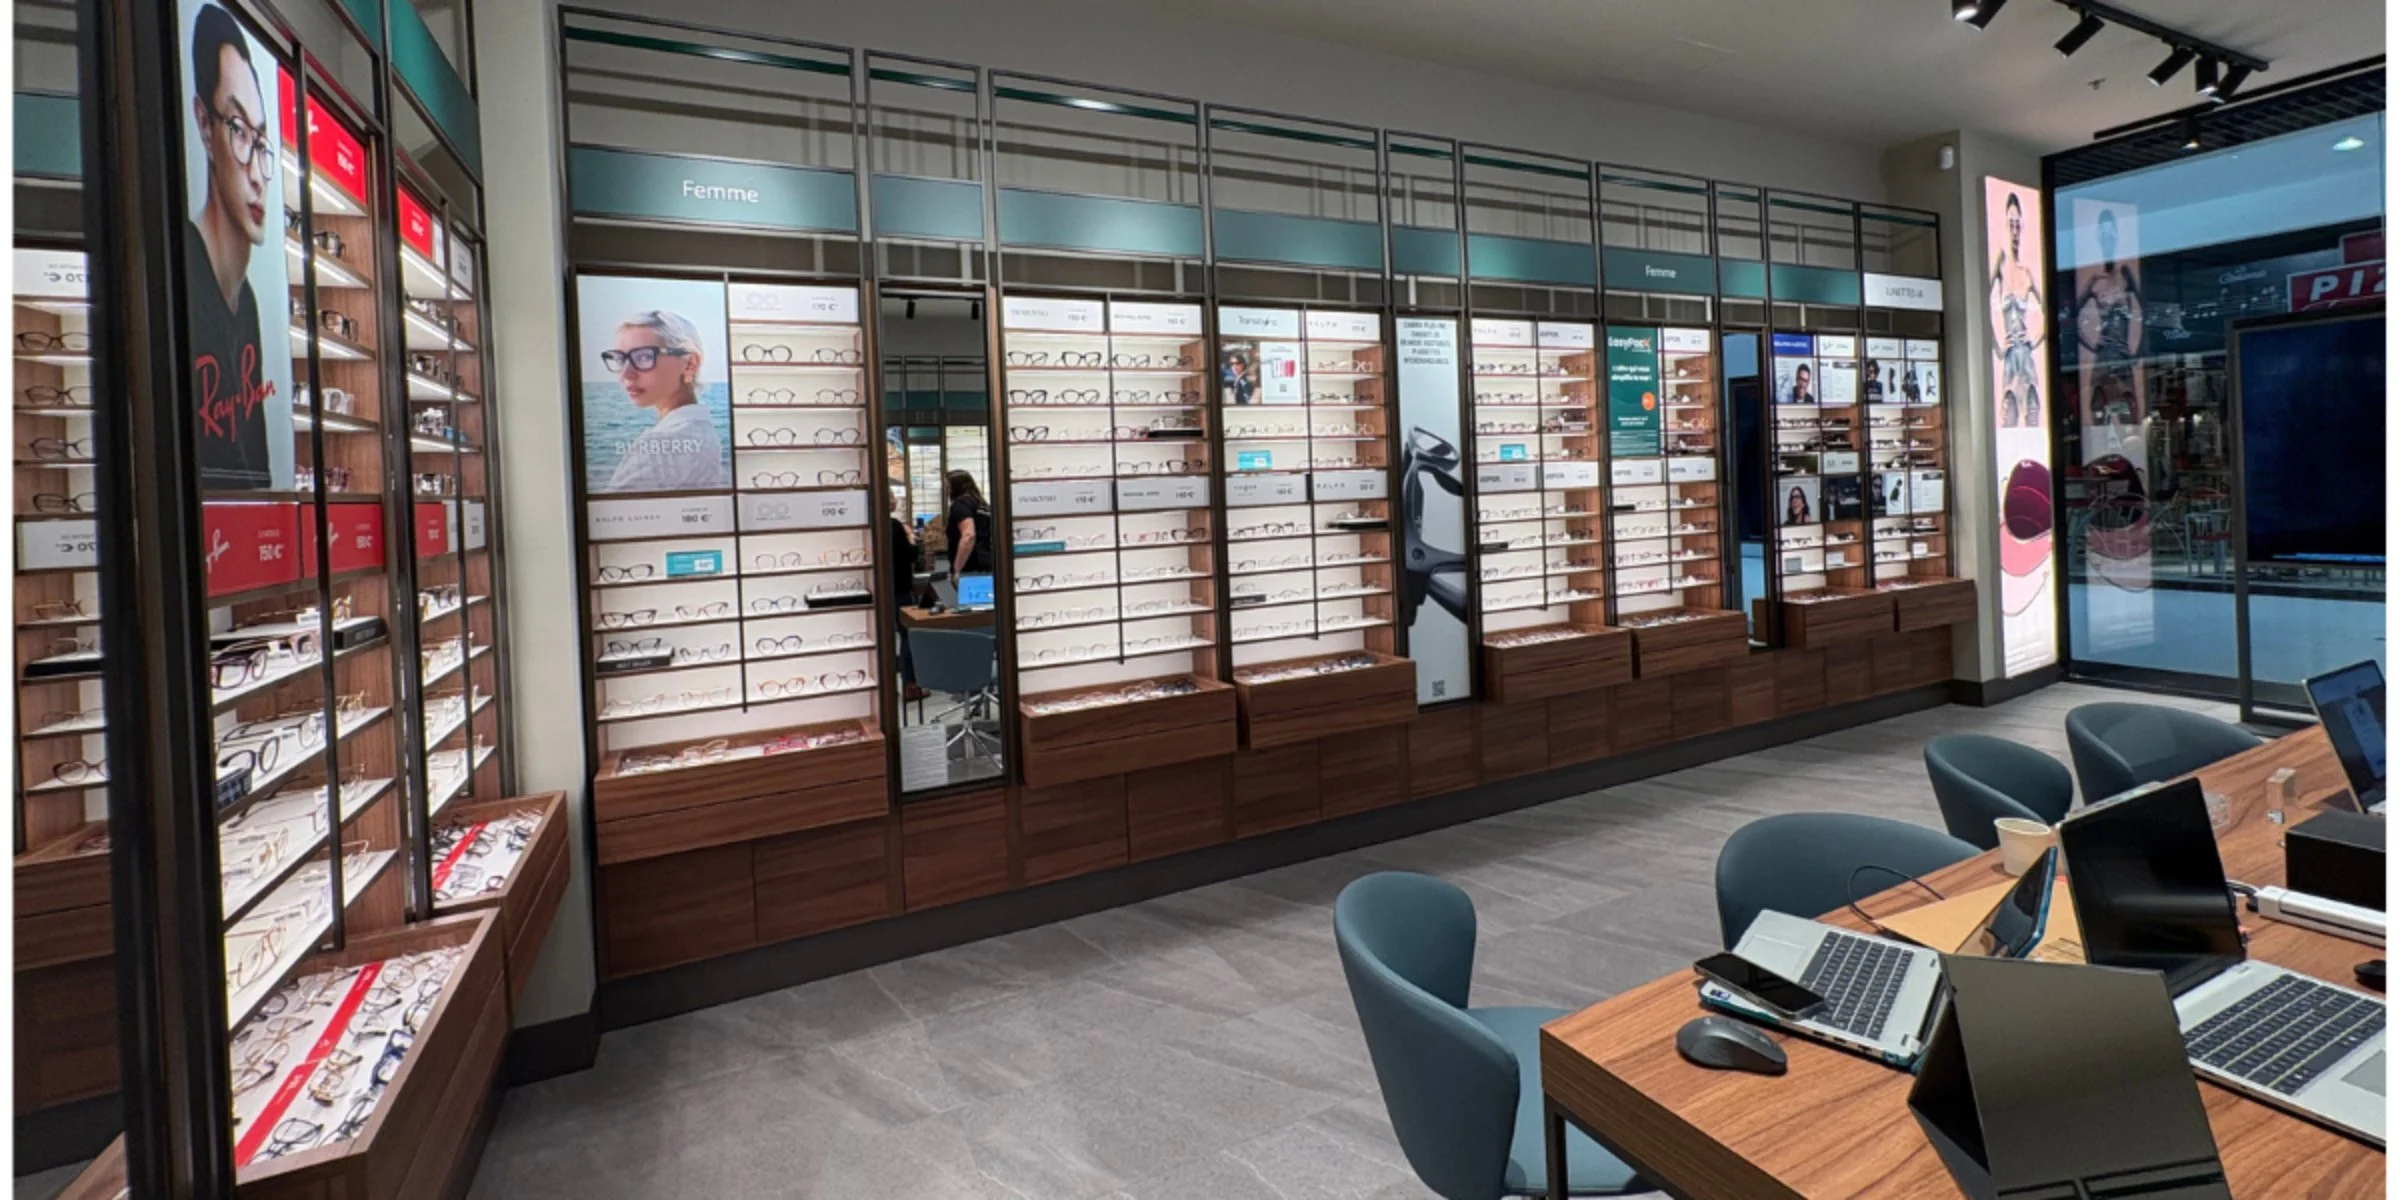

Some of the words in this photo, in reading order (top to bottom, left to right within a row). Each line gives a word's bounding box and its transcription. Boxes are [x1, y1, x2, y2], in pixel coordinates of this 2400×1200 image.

[682, 179, 760, 203] Femme
[1645, 263, 1677, 279] Femme
[615, 438, 702, 456] BURBERRY
